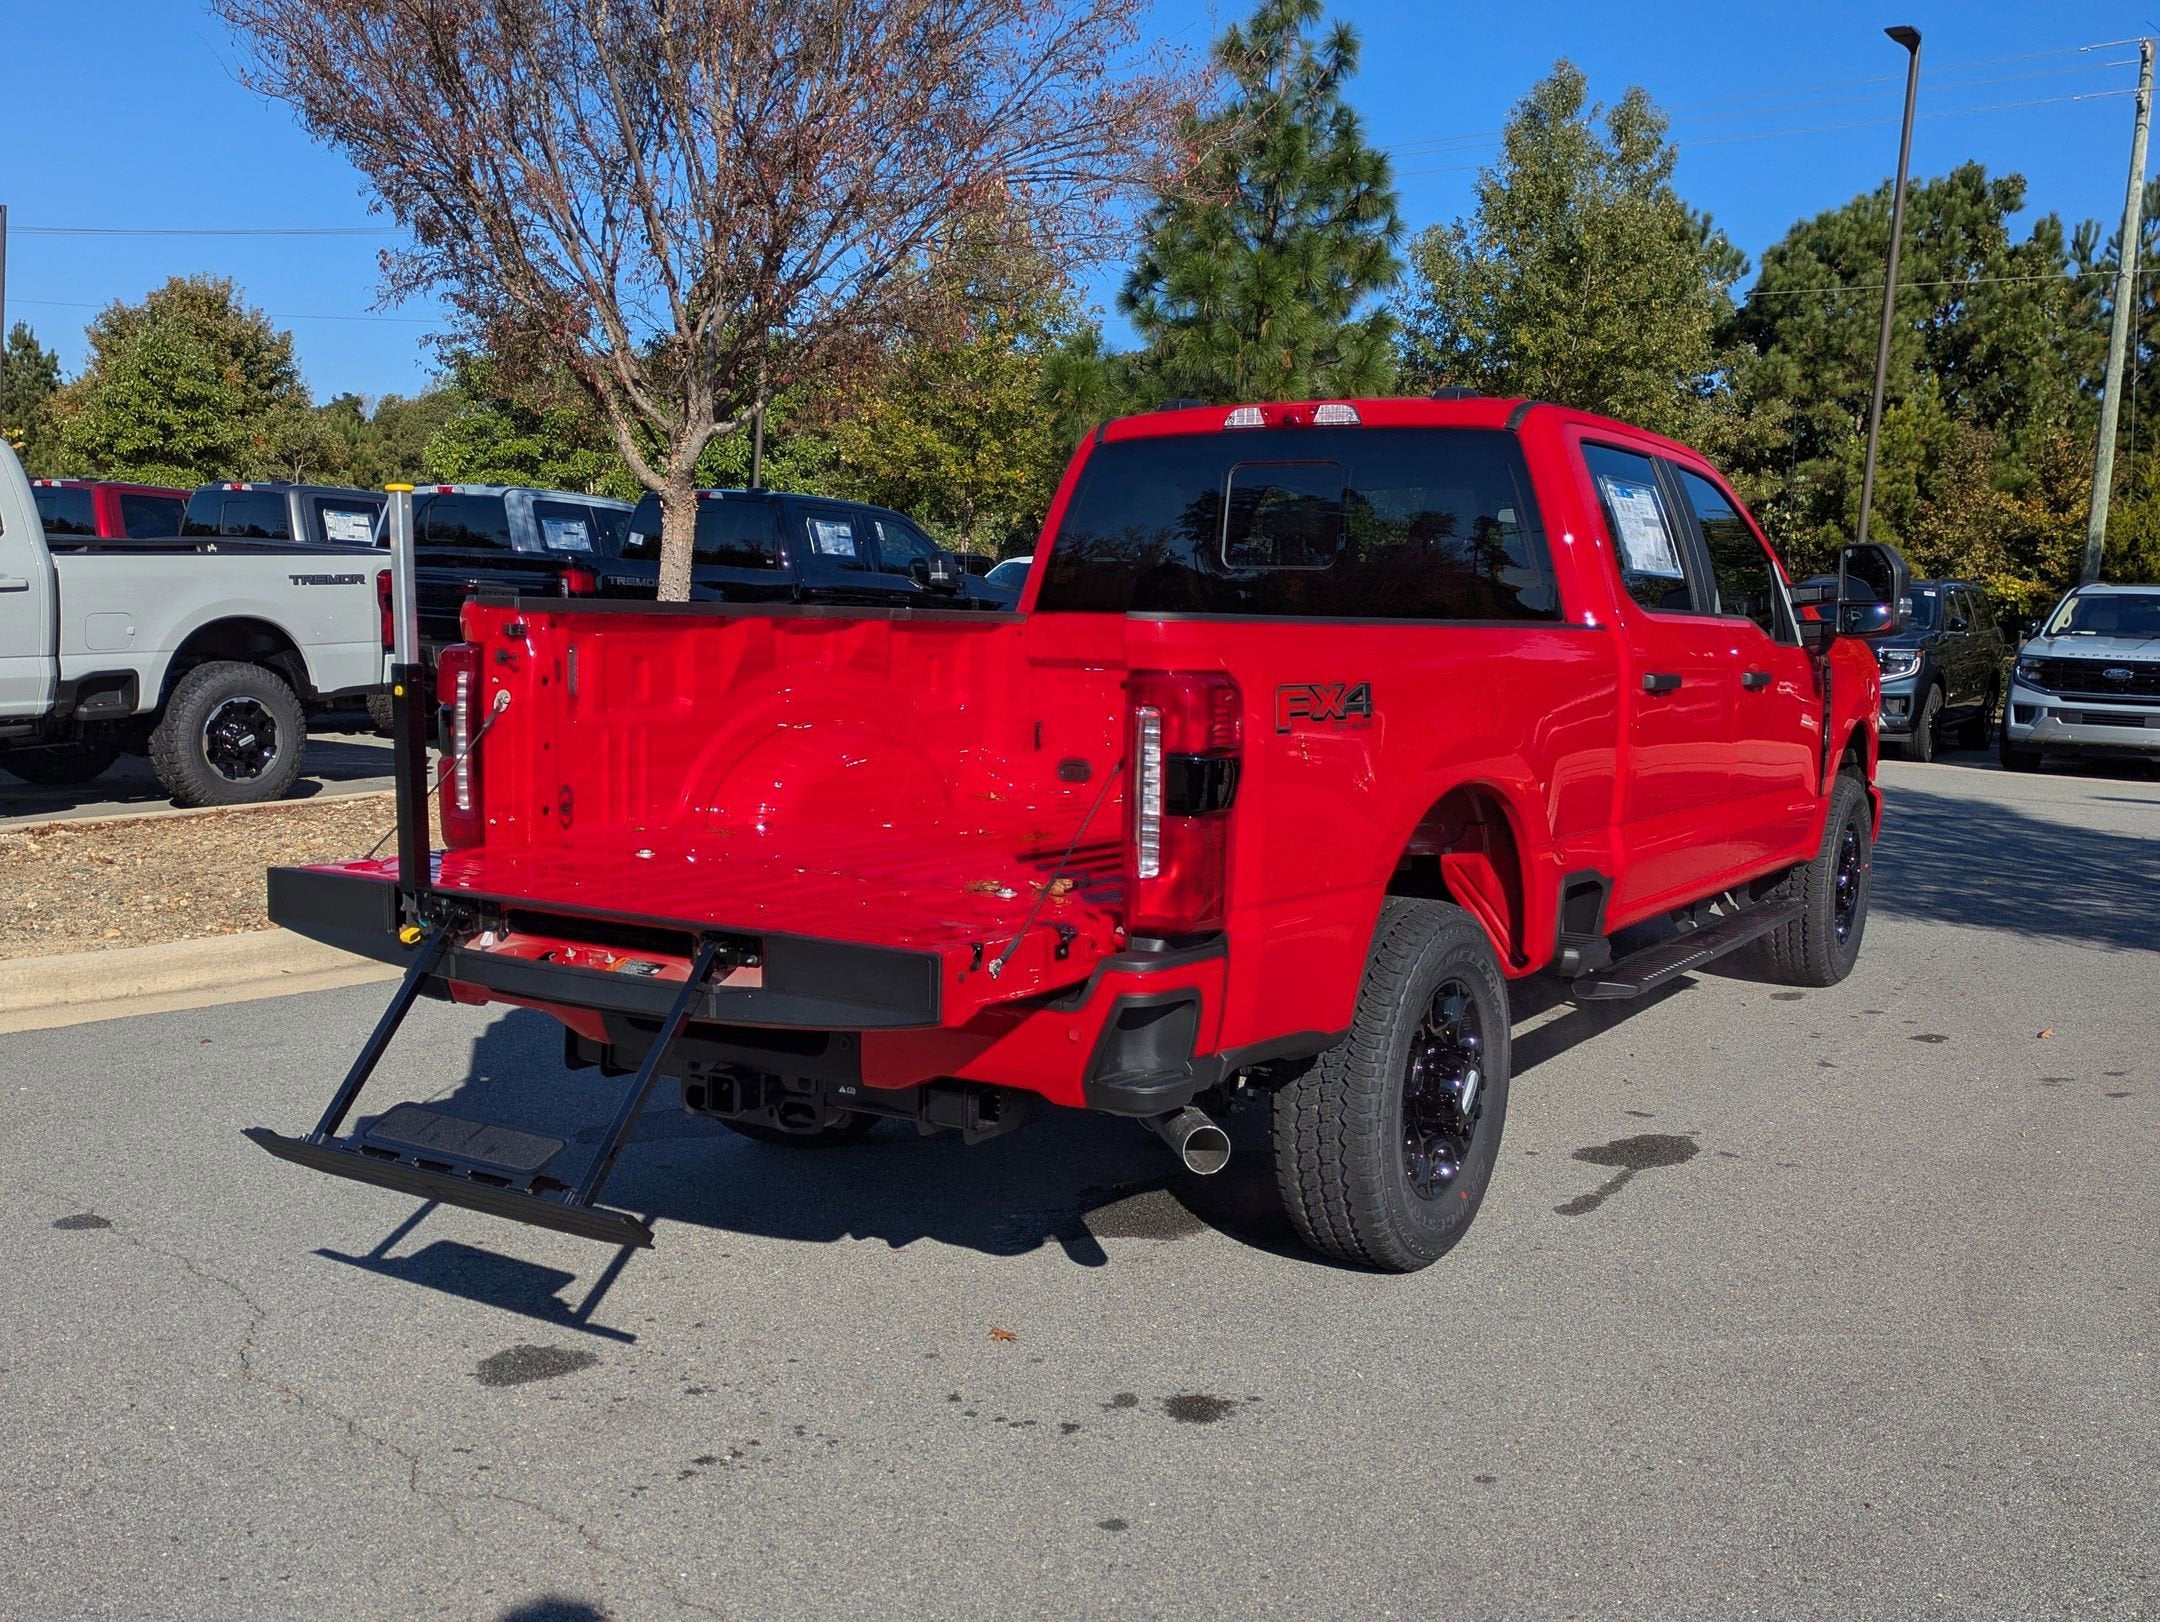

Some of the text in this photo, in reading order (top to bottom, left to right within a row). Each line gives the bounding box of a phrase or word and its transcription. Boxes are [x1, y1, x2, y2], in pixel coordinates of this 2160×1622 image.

[288, 574, 366, 585] TREMOR
[608, 576, 659, 587] TREMO
[1276, 682, 1371, 735] FX4
